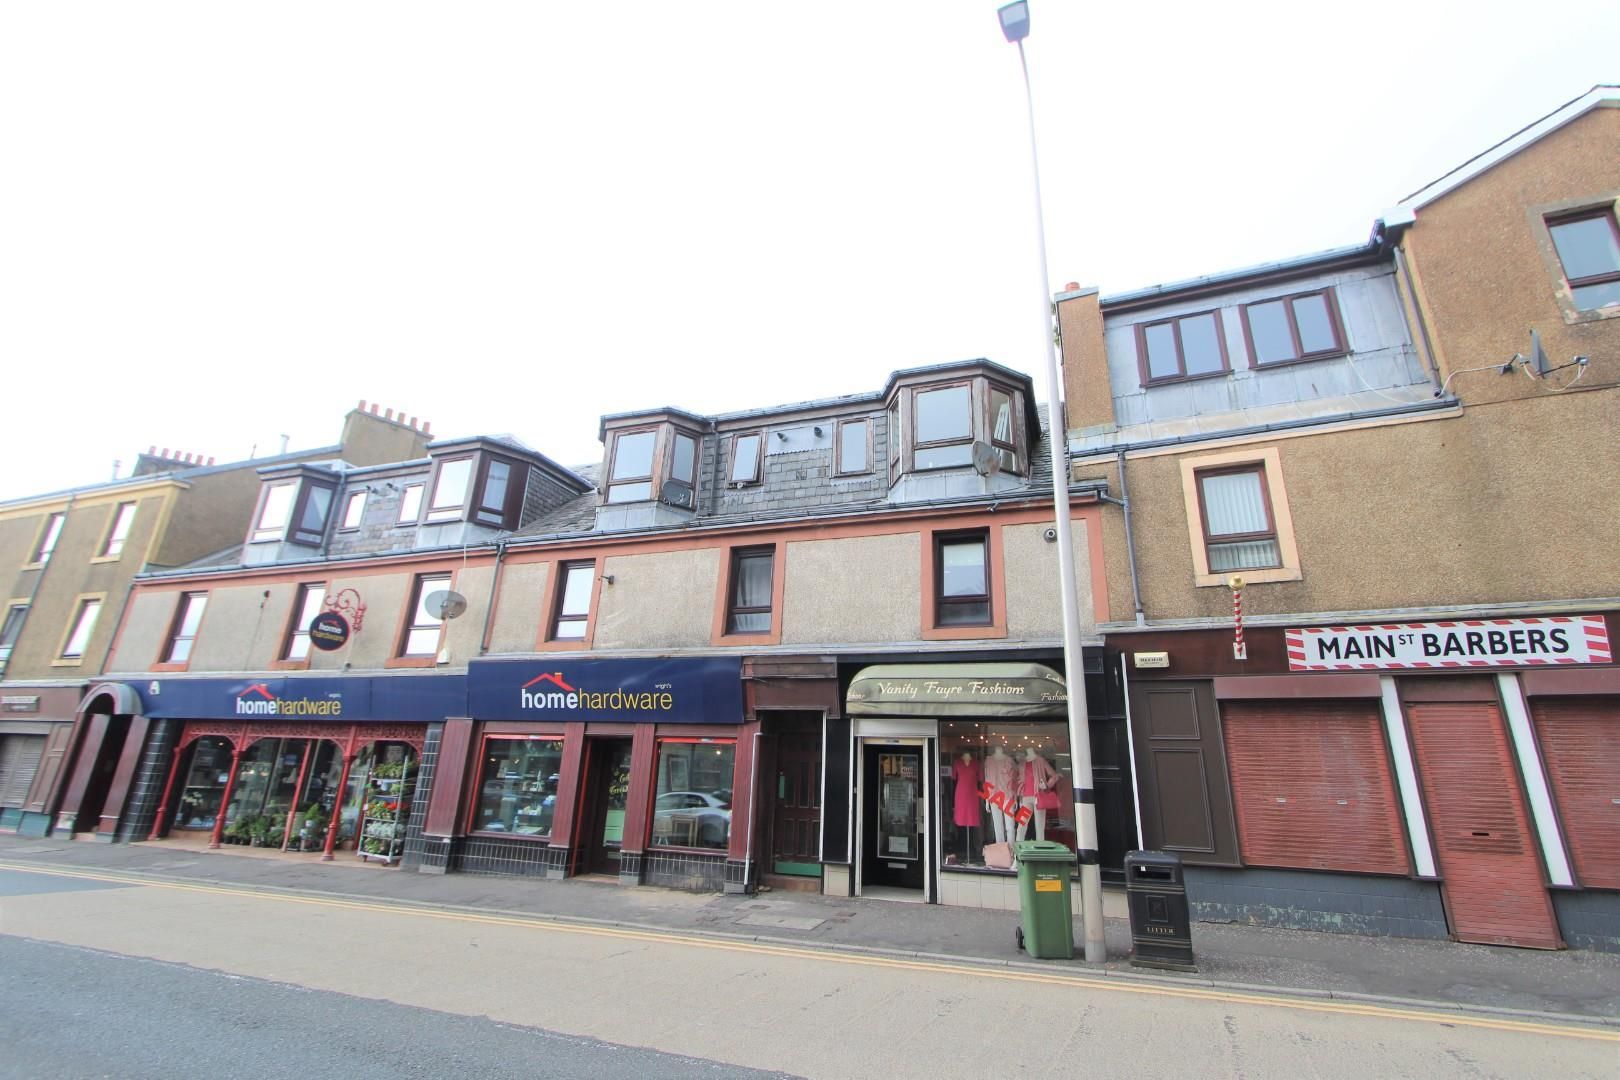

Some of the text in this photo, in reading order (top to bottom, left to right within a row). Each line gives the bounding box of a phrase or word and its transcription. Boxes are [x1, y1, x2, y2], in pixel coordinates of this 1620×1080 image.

[1317, 628, 1570, 660] MAIN ST BARBERS
[878, 680, 1025, 699] Vanity Fayre Fashions
[1040, 690, 1069, 702] Fashion
[976, 781, 1033, 826] SALE
